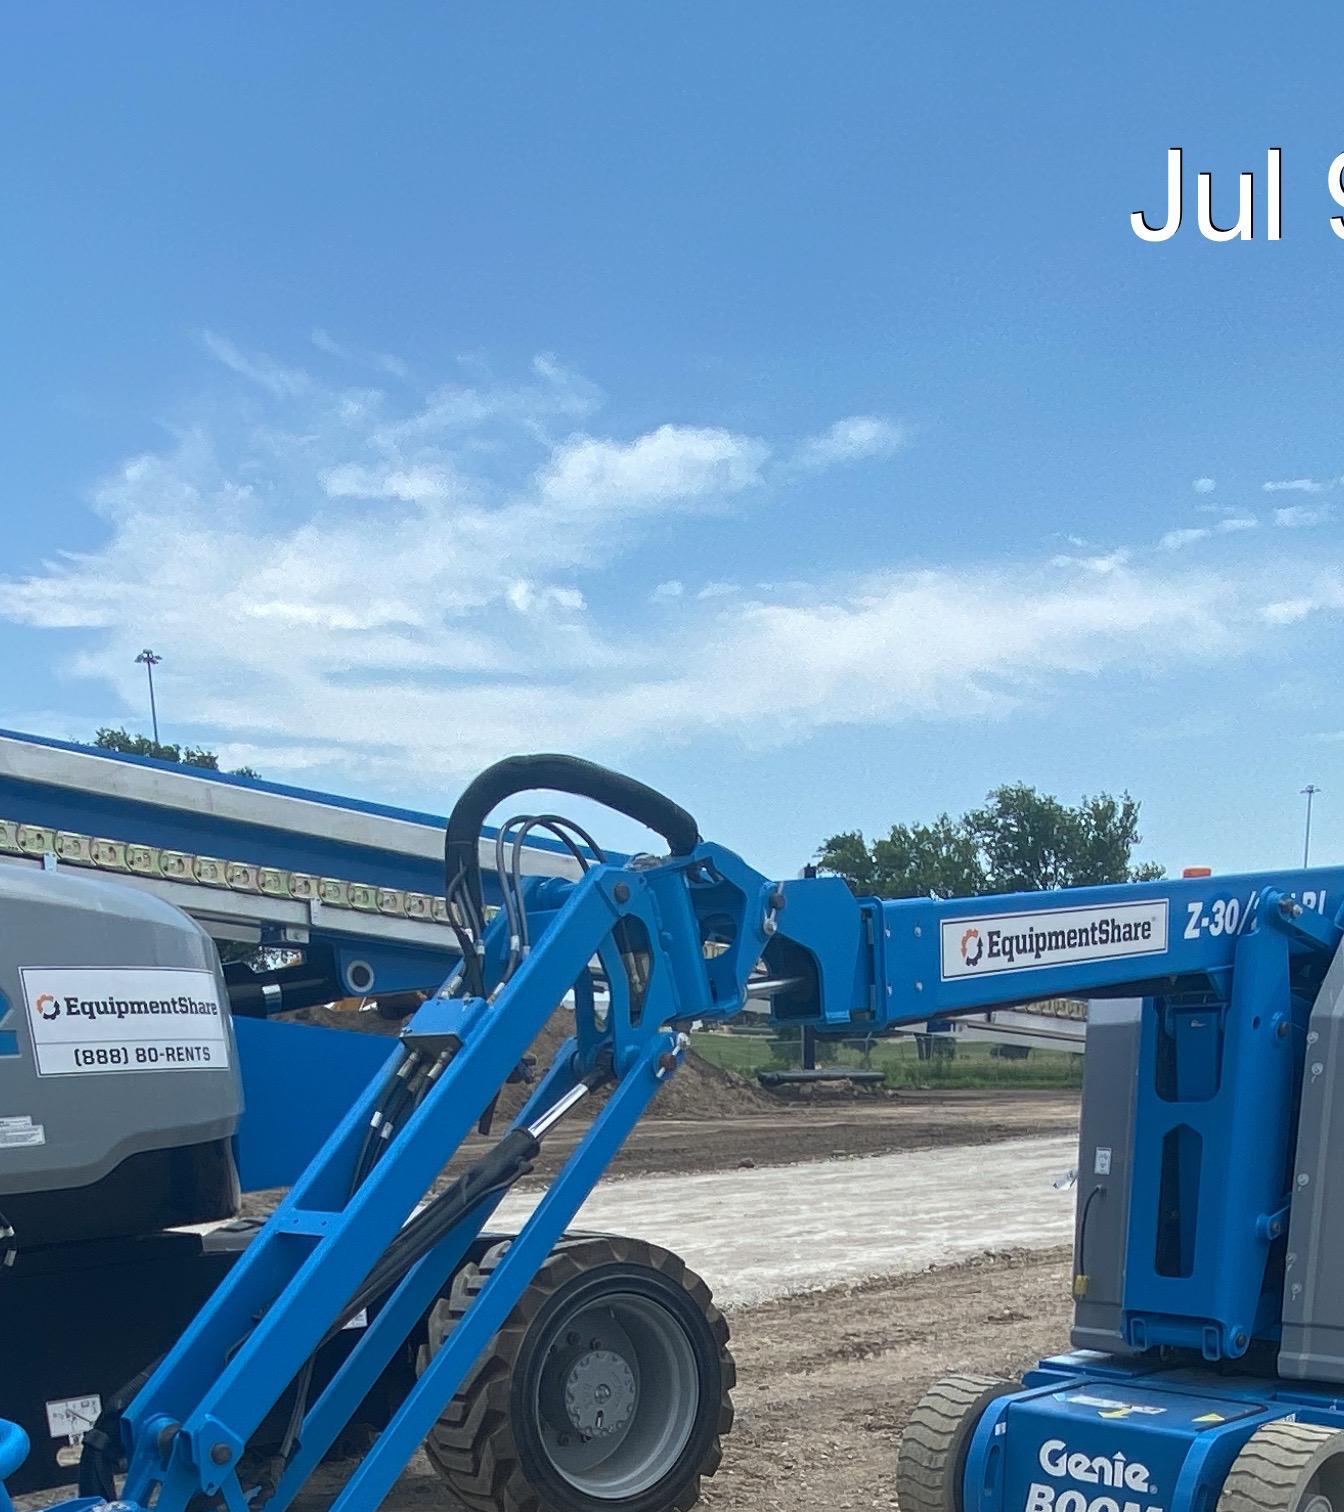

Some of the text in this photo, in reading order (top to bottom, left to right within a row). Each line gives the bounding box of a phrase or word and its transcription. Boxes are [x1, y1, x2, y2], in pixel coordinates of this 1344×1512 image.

[987, 918, 1152, 963] EquipmentShare
[63, 997, 219, 1019] EquipmentShare
[74, 1046, 211, 1067] (888) 80-RENTS
[1039, 1439, 1150, 1493] Genie
